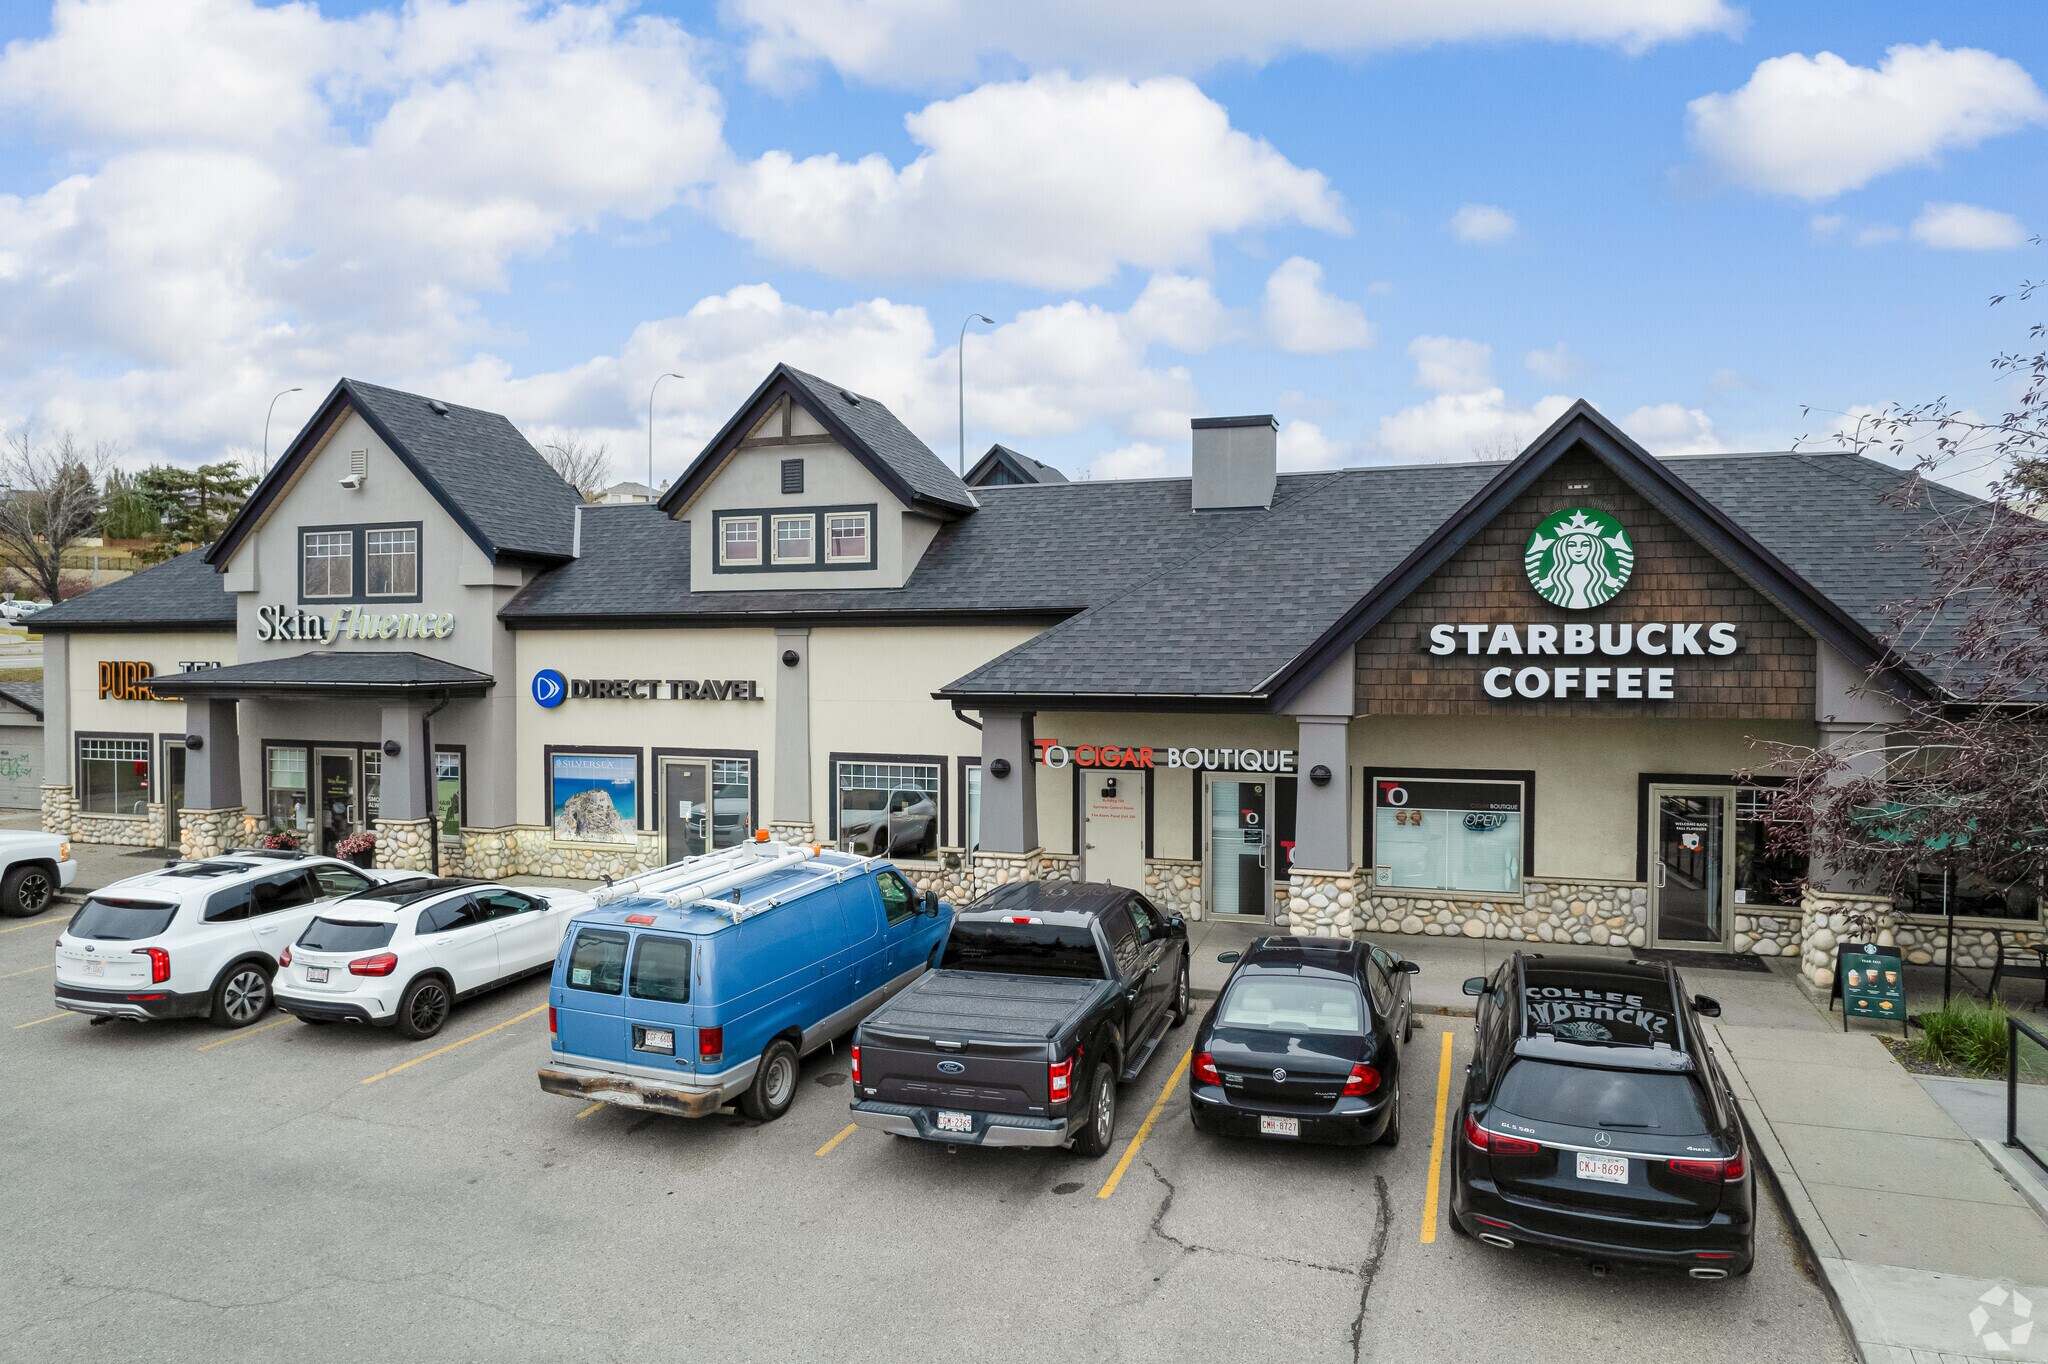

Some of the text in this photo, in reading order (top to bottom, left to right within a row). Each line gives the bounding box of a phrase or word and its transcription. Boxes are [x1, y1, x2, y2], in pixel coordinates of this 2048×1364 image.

[1429, 622, 1738, 656] STARBUCKS
[1483, 666, 1675, 699] COFFEE
[571, 679, 765, 701] DIRECT TRAVEL
[562, 759, 614, 769] SILVERSEA
[1075, 744, 1154, 768] CIGAR
[1167, 748, 1294, 772] BOUTIQUE
[1490, 803, 1518, 811] BOUTIQUE
[1465, 813, 1502, 827] OPEN
[1262, 1120, 1297, 1132] CMH-8727
[1501, 1122, 1536, 1134] GLS 580
[1578, 1161, 1625, 1176] CKJ-8699
